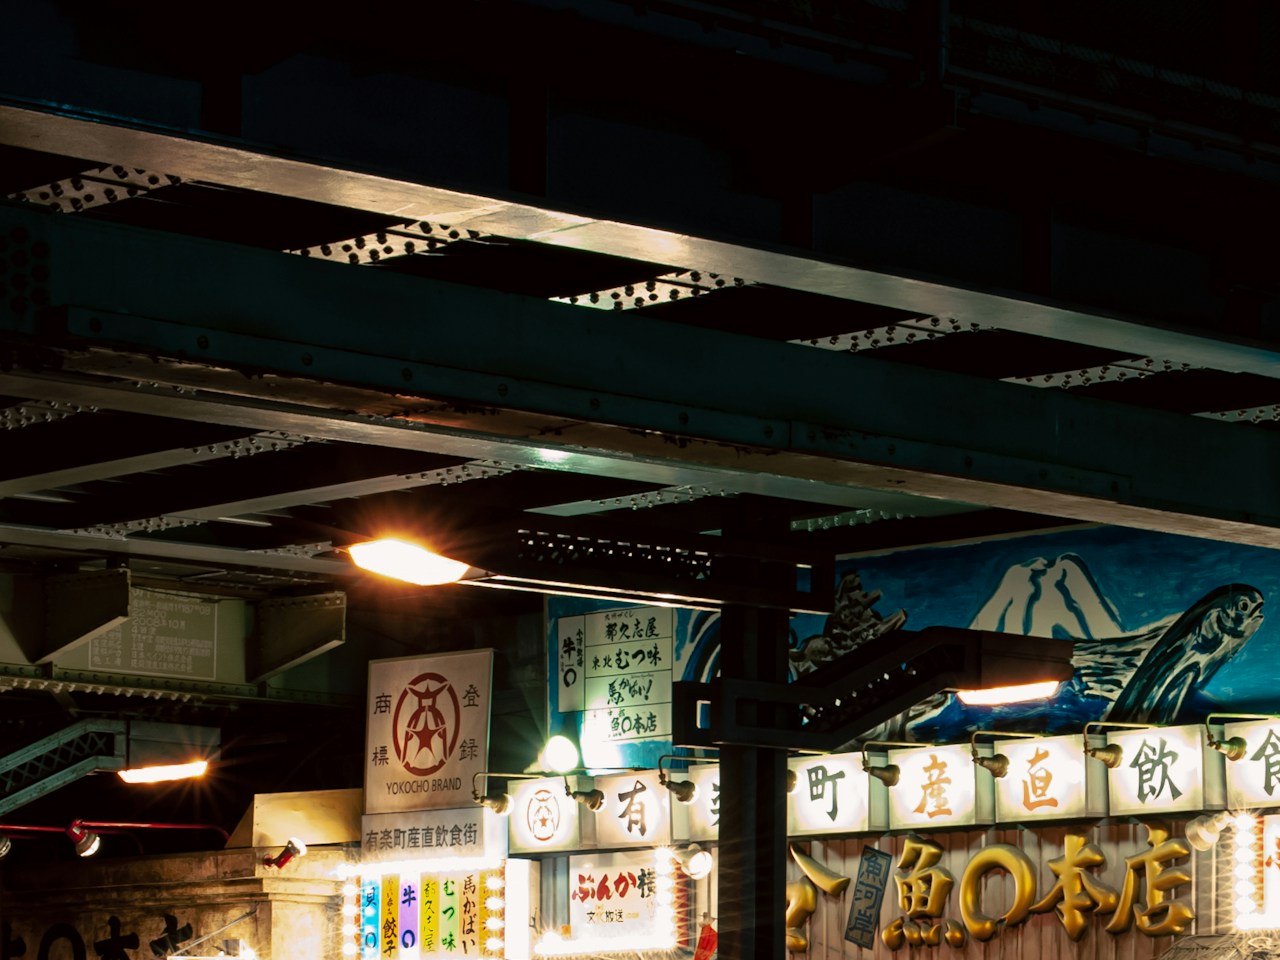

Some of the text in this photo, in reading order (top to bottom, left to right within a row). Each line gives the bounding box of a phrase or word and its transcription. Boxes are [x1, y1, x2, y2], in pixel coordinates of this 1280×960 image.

[386, 777, 462, 795] YOKOCHO BRAND
[366, 823, 478, 851] 有楽町産直飲食街
[442, 878, 457, 952] むつ味
[462, 874, 477, 954] 馬かばい
